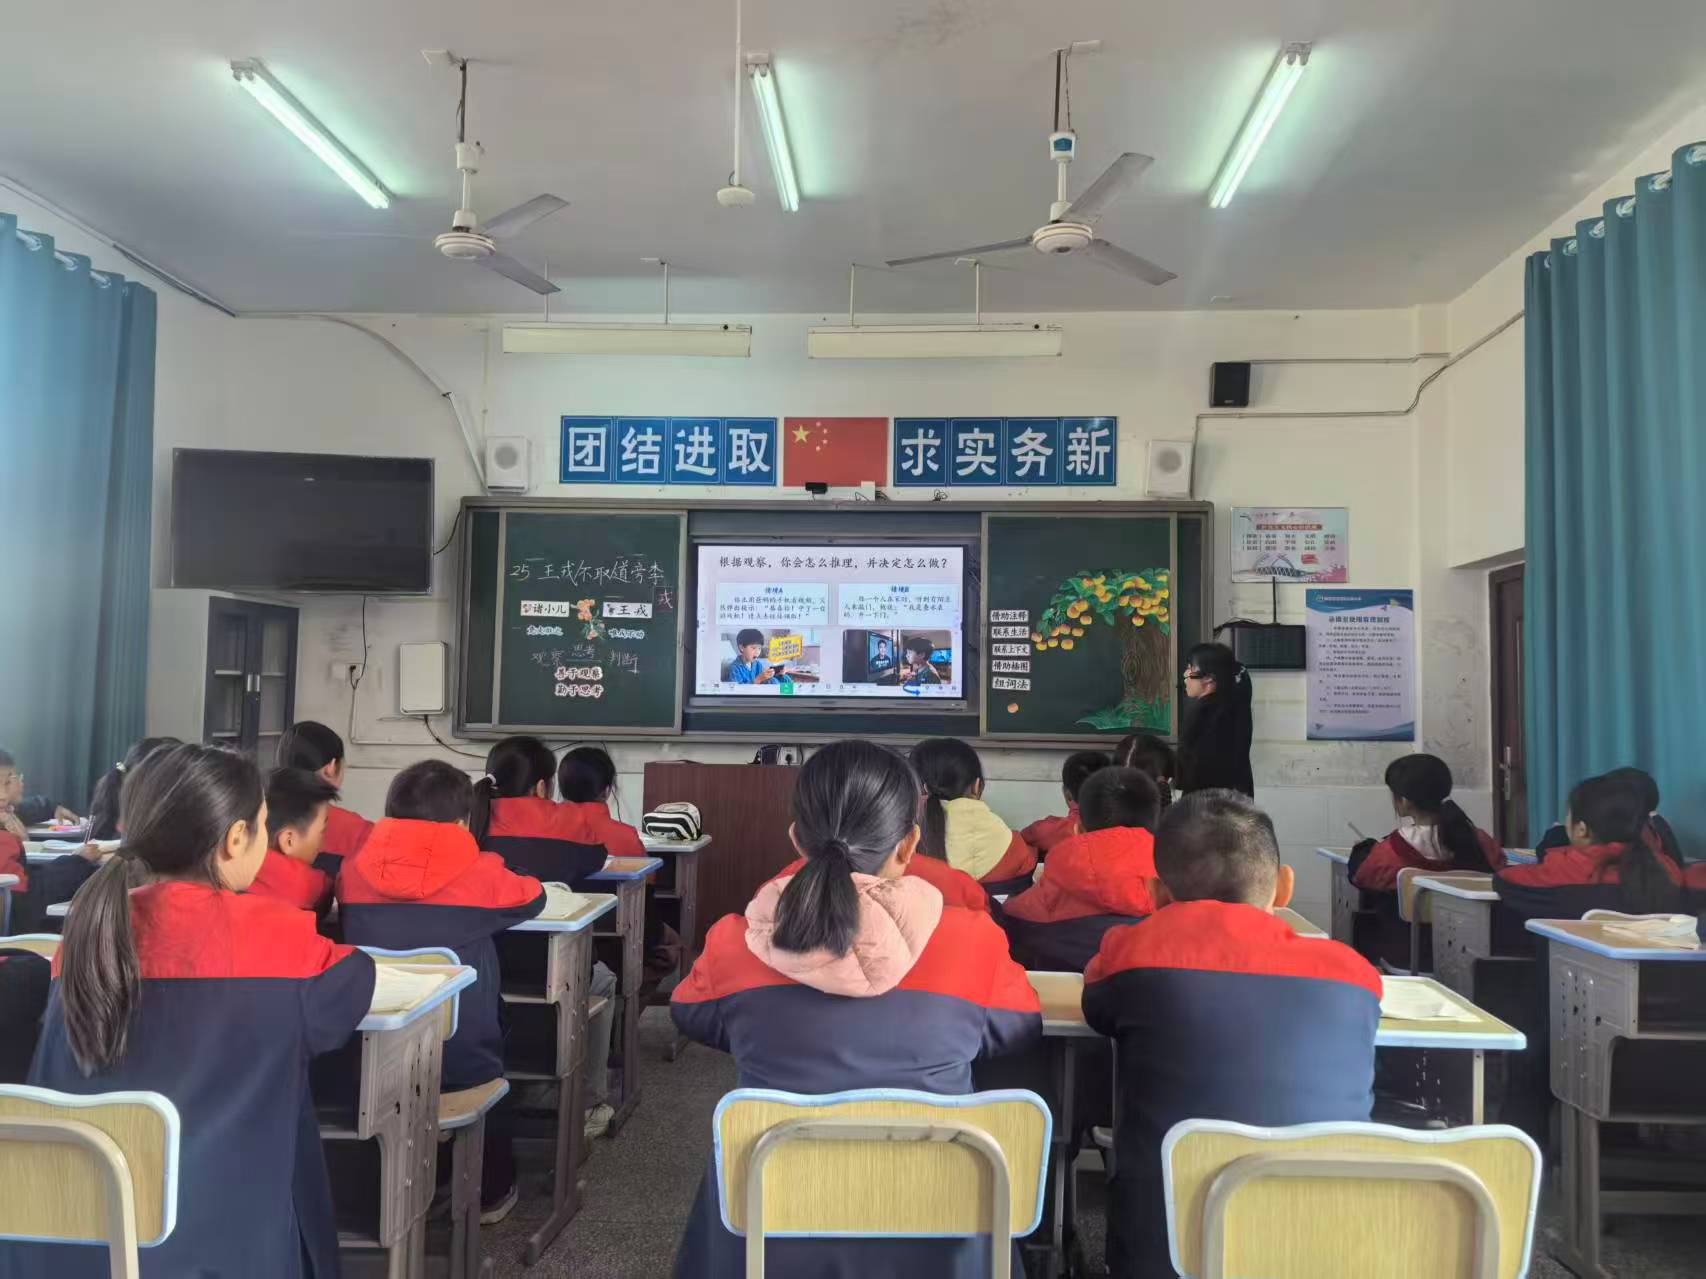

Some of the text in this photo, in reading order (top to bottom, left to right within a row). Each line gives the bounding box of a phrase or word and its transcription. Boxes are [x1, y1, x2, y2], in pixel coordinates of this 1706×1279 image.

[568, 427, 771, 476] 团结进取
[901, 427, 1111, 477] 求实务新
[719, 556, 948, 569] 根据观察，你会怎么推理，并决定怎么做？
[509, 560, 664, 586] 25 王戎不取道旁李
[533, 603, 567, 614] 诸小儿
[617, 605, 648, 617] 王戎
[992, 610, 1026, 621] 借助注释
[993, 627, 1027, 637] 联系生活
[994, 645, 1028, 654] 联系上下文
[571, 644, 597, 659] 思考
[609, 650, 639, 673] 判断
[993, 661, 1028, 671] 借助插图
[556, 666, 602, 680] 善于观察
[995, 678, 1028, 689] 组词法
[556, 684, 603, 698] 勤于思考
